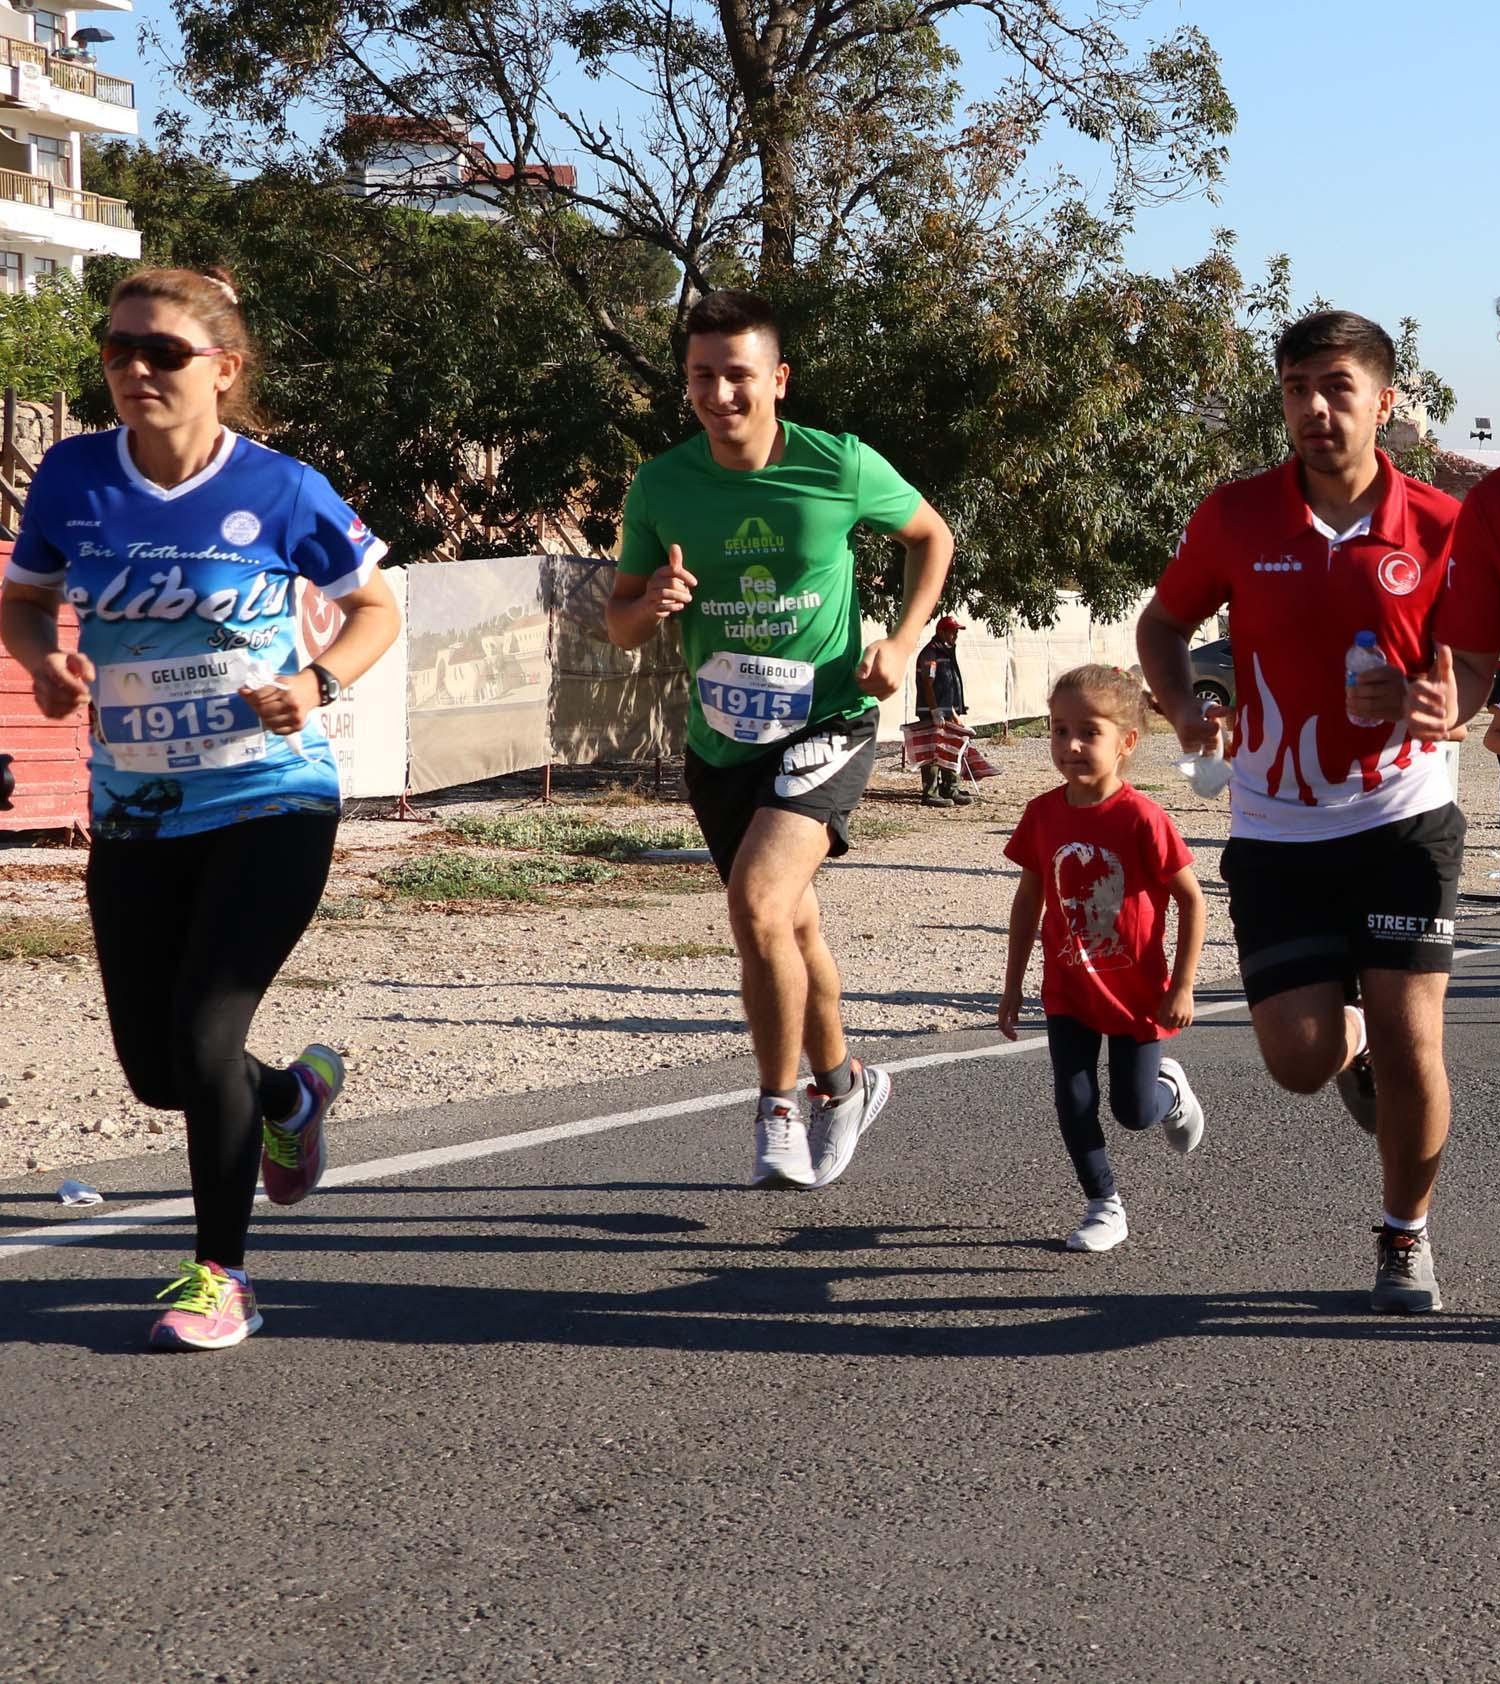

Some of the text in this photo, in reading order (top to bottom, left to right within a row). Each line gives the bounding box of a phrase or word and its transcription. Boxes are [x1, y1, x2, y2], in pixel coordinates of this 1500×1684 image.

[78, 541, 114, 557] Bir
[67, 563, 291, 622] elibolu
[739, 576, 777, 593] Pes
[700, 590, 822, 616] etmeyenlerin
[724, 615, 798, 638] izinden!
[710, 685, 793, 719] 1915
[122, 697, 235, 741] 1915
[1367, 914, 1428, 933] STREET
